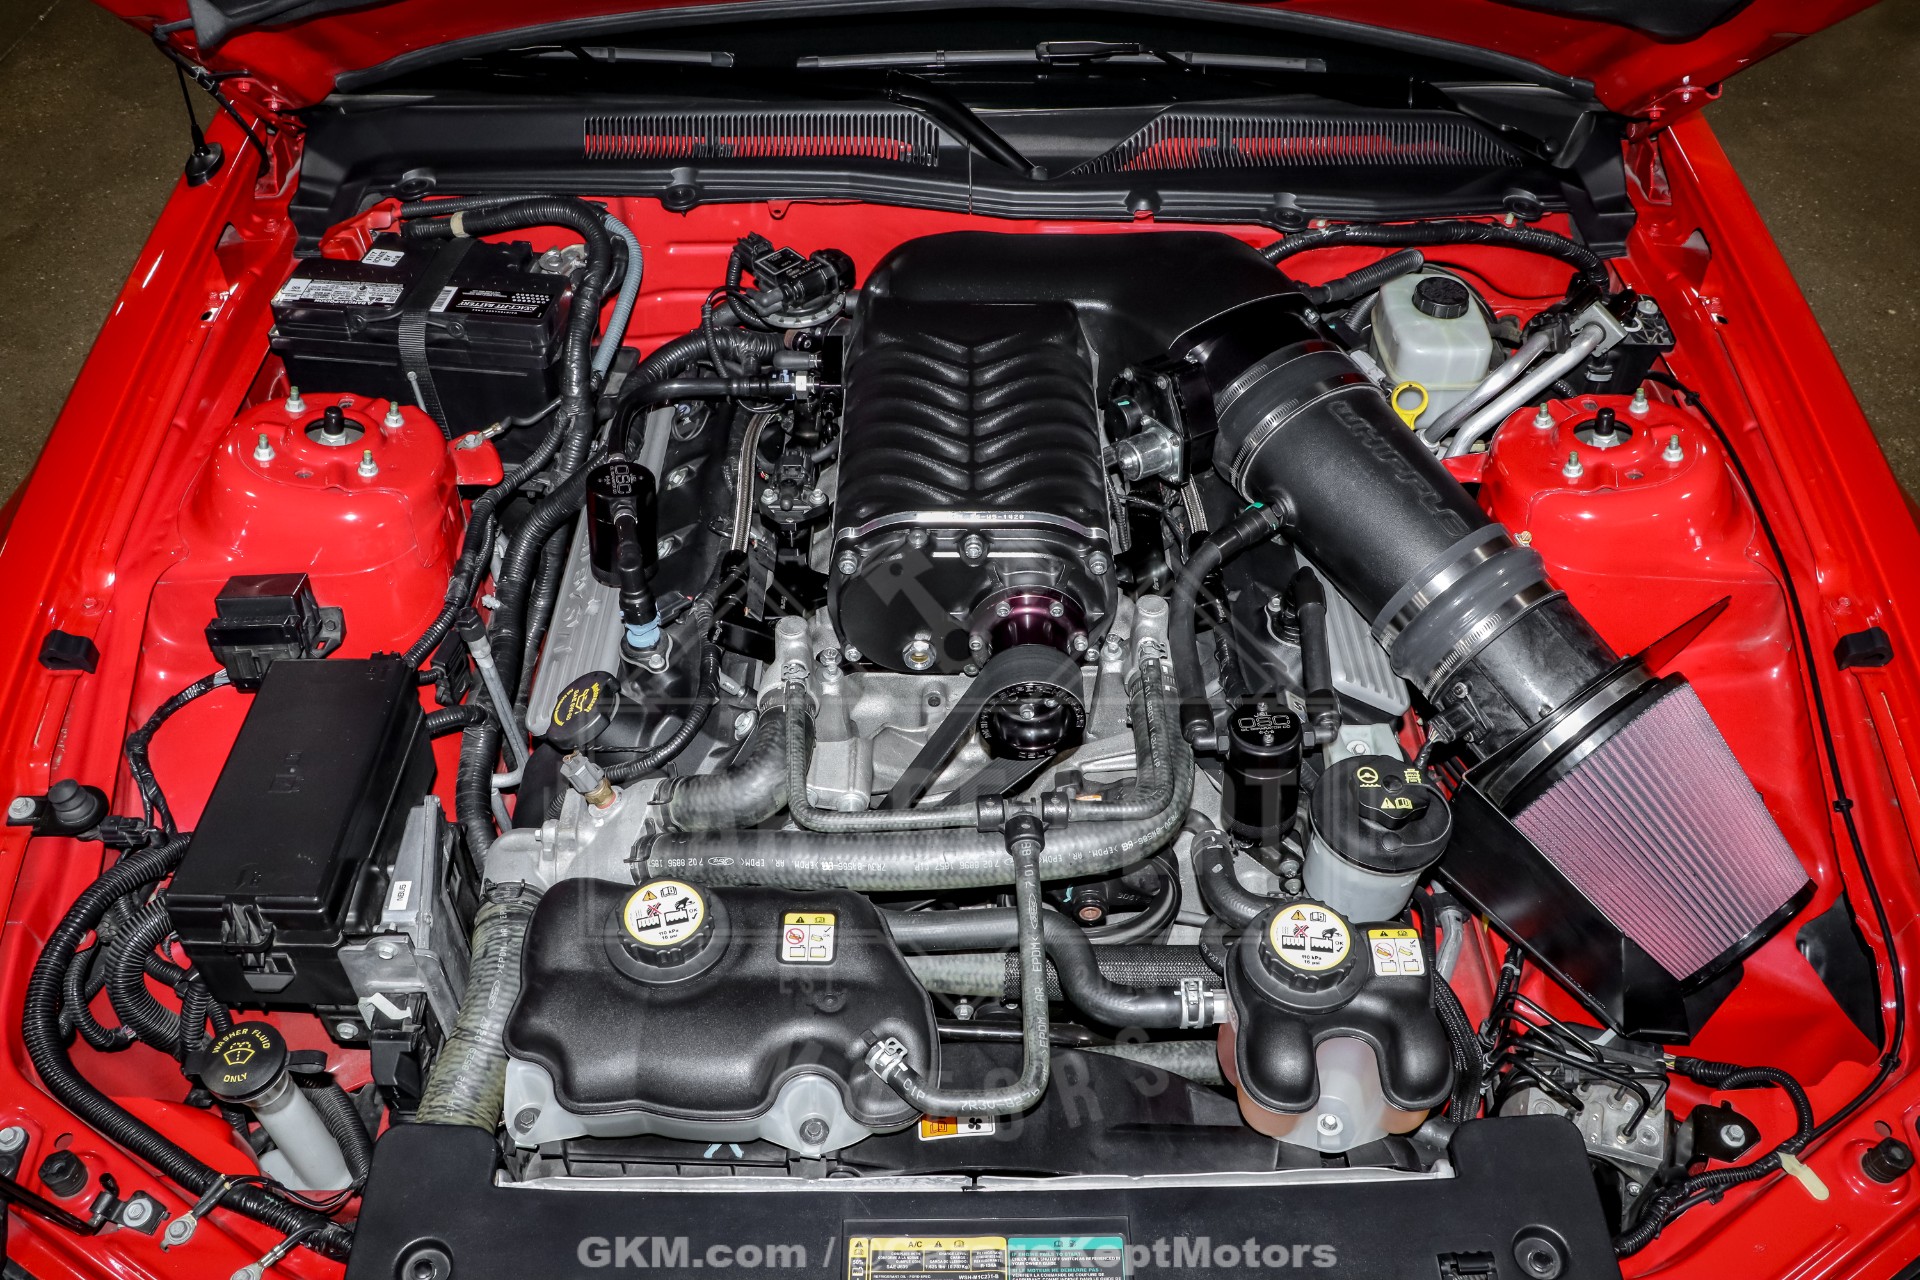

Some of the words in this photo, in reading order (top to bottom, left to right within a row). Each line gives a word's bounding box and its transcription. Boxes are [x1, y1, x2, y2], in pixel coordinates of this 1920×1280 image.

[457, 301, 495, 309] BATTERY
[496, 303, 537, 311] EXACT-FIT
[667, 858, 686, 867] 8896
[212, 1028, 248, 1054] WASHER
[251, 1029, 271, 1050] FLUID
[223, 1072, 248, 1083] ONLY
[903, 1078, 926, 1101] CIP
